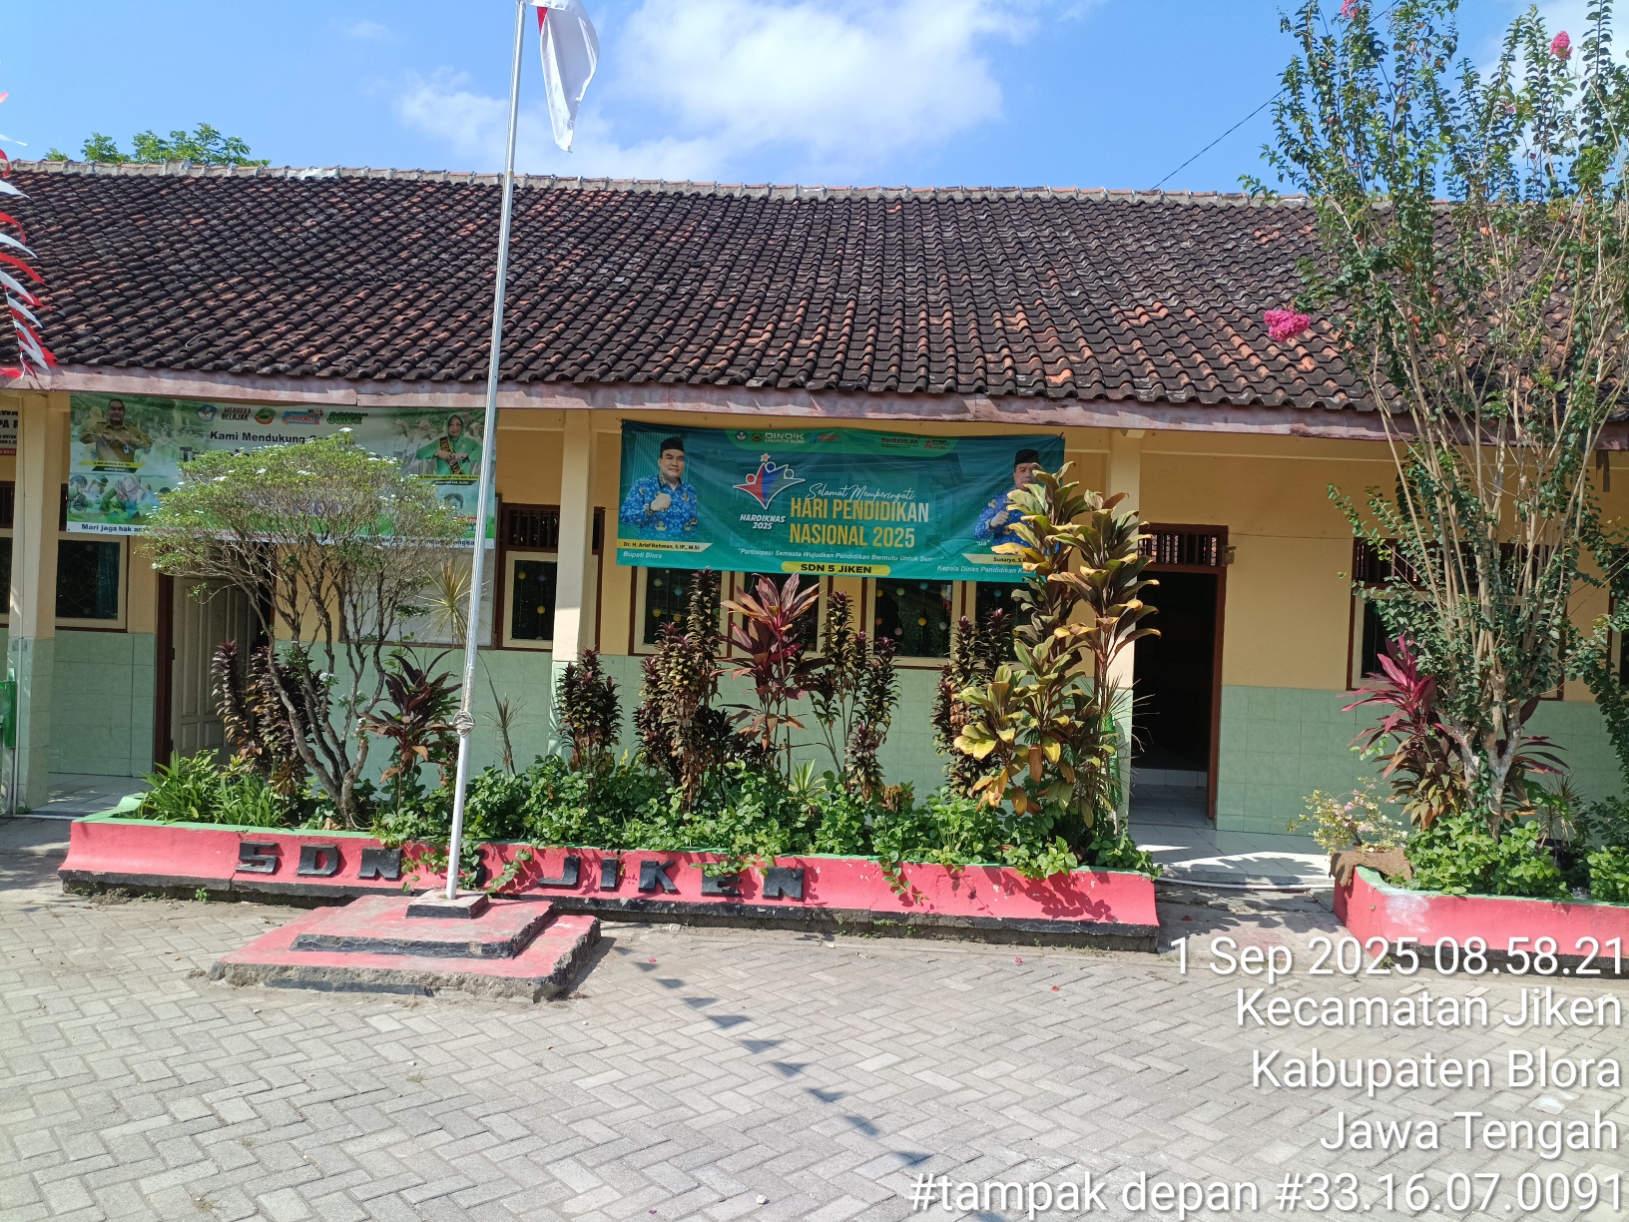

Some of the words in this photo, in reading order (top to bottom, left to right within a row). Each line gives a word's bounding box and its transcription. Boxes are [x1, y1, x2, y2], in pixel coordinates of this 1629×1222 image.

[210, 430, 238, 441] Kami
[242, 432, 306, 445] Mendukung
[804, 483, 849, 500] Selamat
[790, 497, 829, 519] HARI
[832, 498, 930, 523] PENDIDIKAN
[739, 513, 786, 523] HARDIKNAS
[81, 523, 99, 531] Mari
[101, 524, 117, 532] jaga
[752, 521, 773, 530] 2025
[789, 523, 869, 547] NASIONAL
[872, 526, 915, 548] 2025
[623, 551, 645, 559] Bupati
[645, 551, 663, 559] Blora
[800, 563, 825, 572] SDN
[827, 564, 835, 573] 5
[837, 564, 872, 574] JIKEN
[937, 564, 959, 573] Kepala
[961, 565, 979, 573] Dinas
[980, 566, 1016, 574] Pendidikan
[234, 841, 403, 880] SDN
[537, 855, 805, 902] JIKEN
